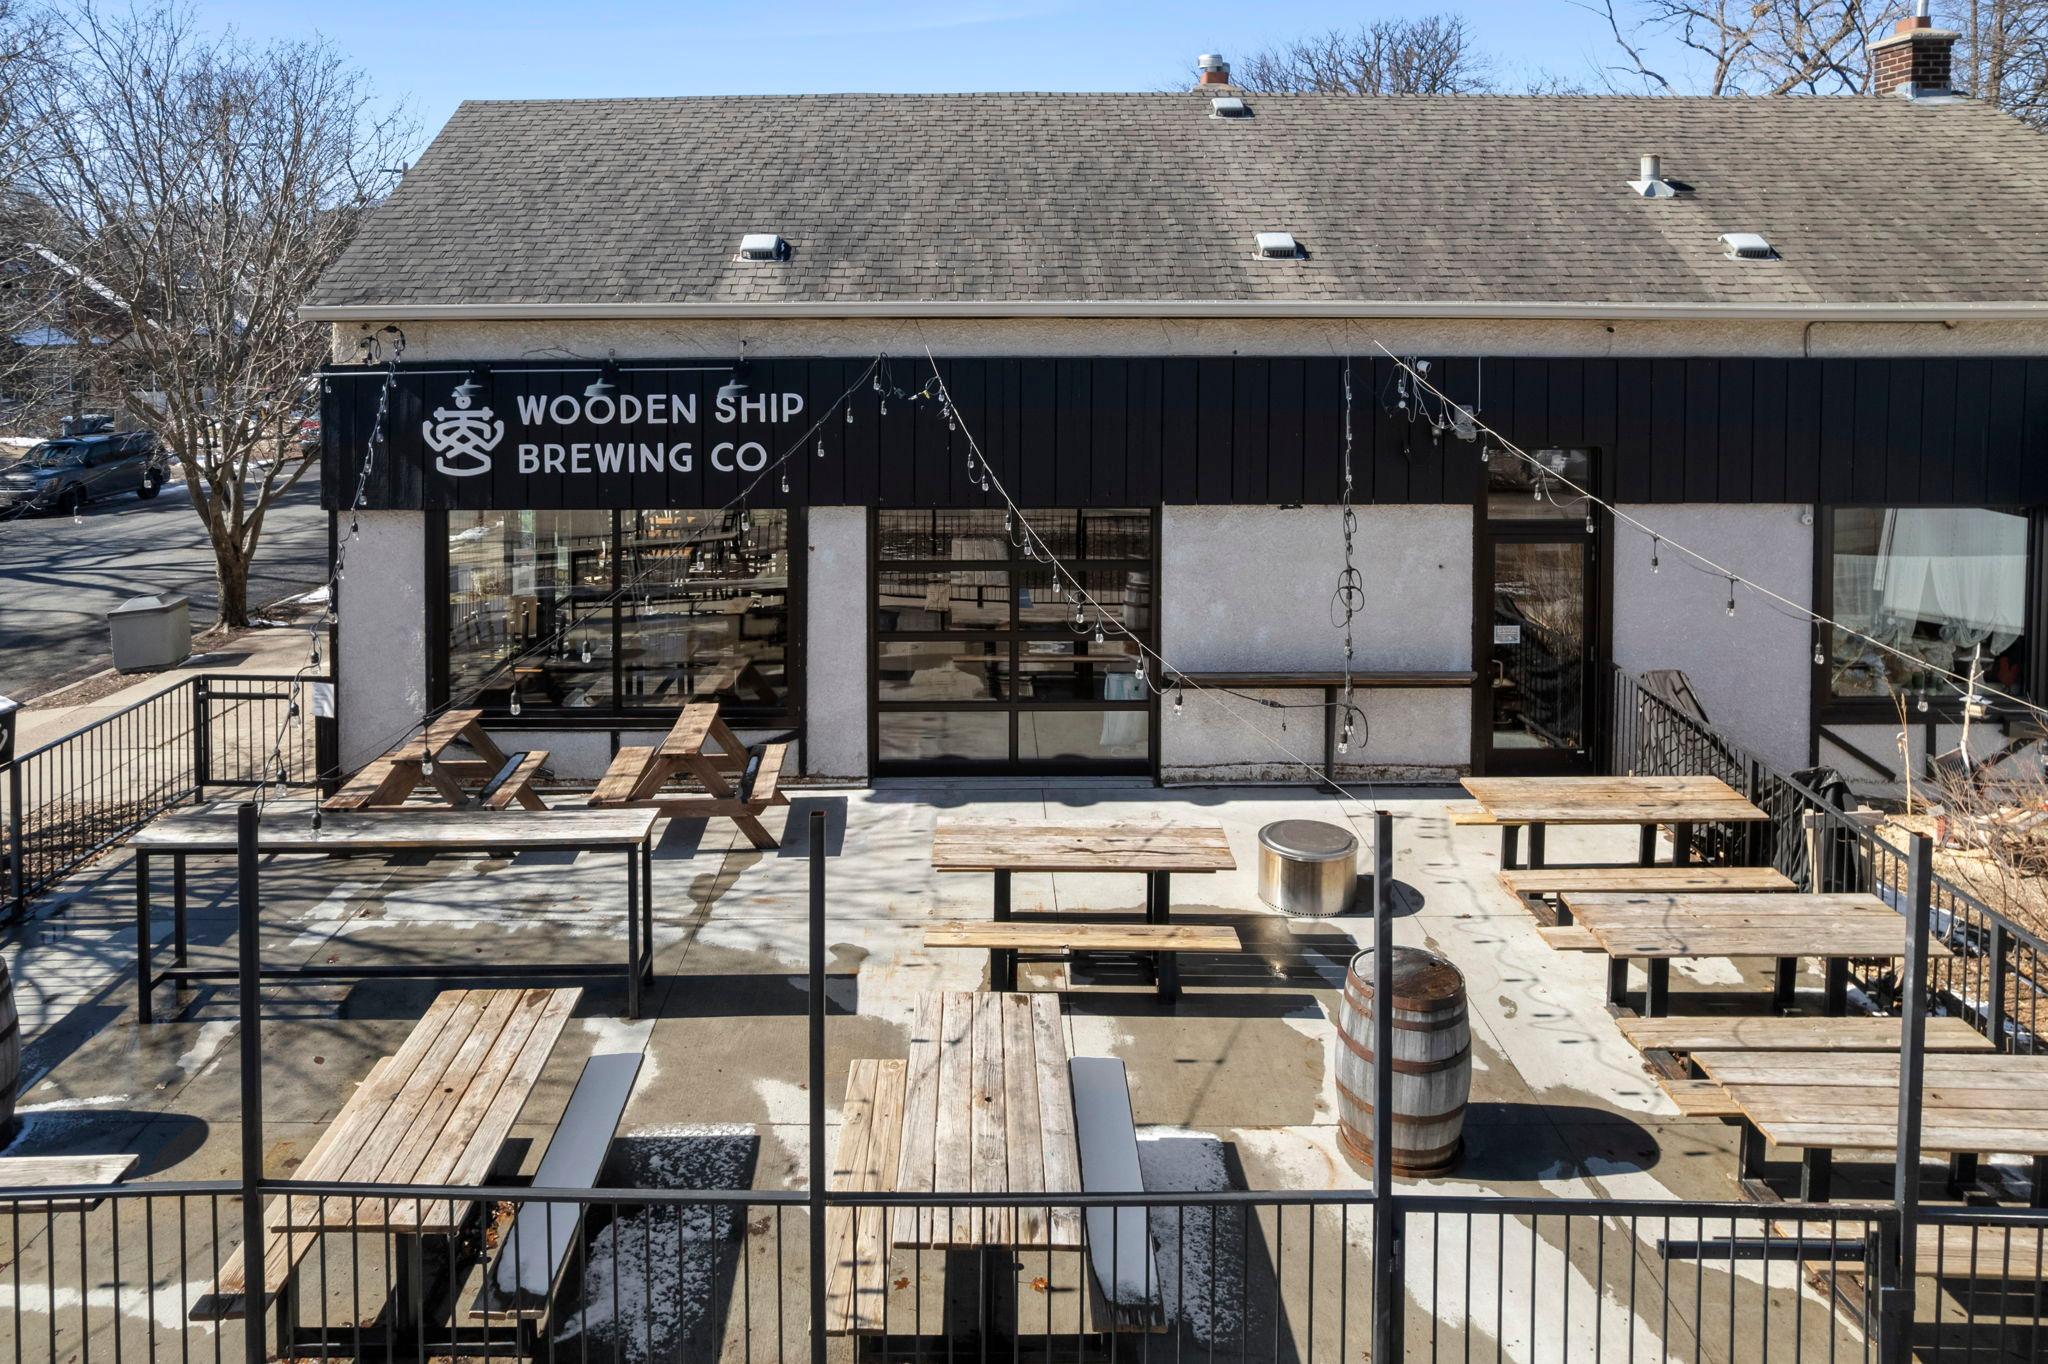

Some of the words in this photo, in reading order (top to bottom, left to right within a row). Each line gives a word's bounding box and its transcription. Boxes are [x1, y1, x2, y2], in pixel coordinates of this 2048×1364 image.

[517, 394, 696, 425] WOODEN
[715, 393, 804, 424] SHIP
[518, 442, 692, 474] BREWING
[710, 442, 767, 473] CO
